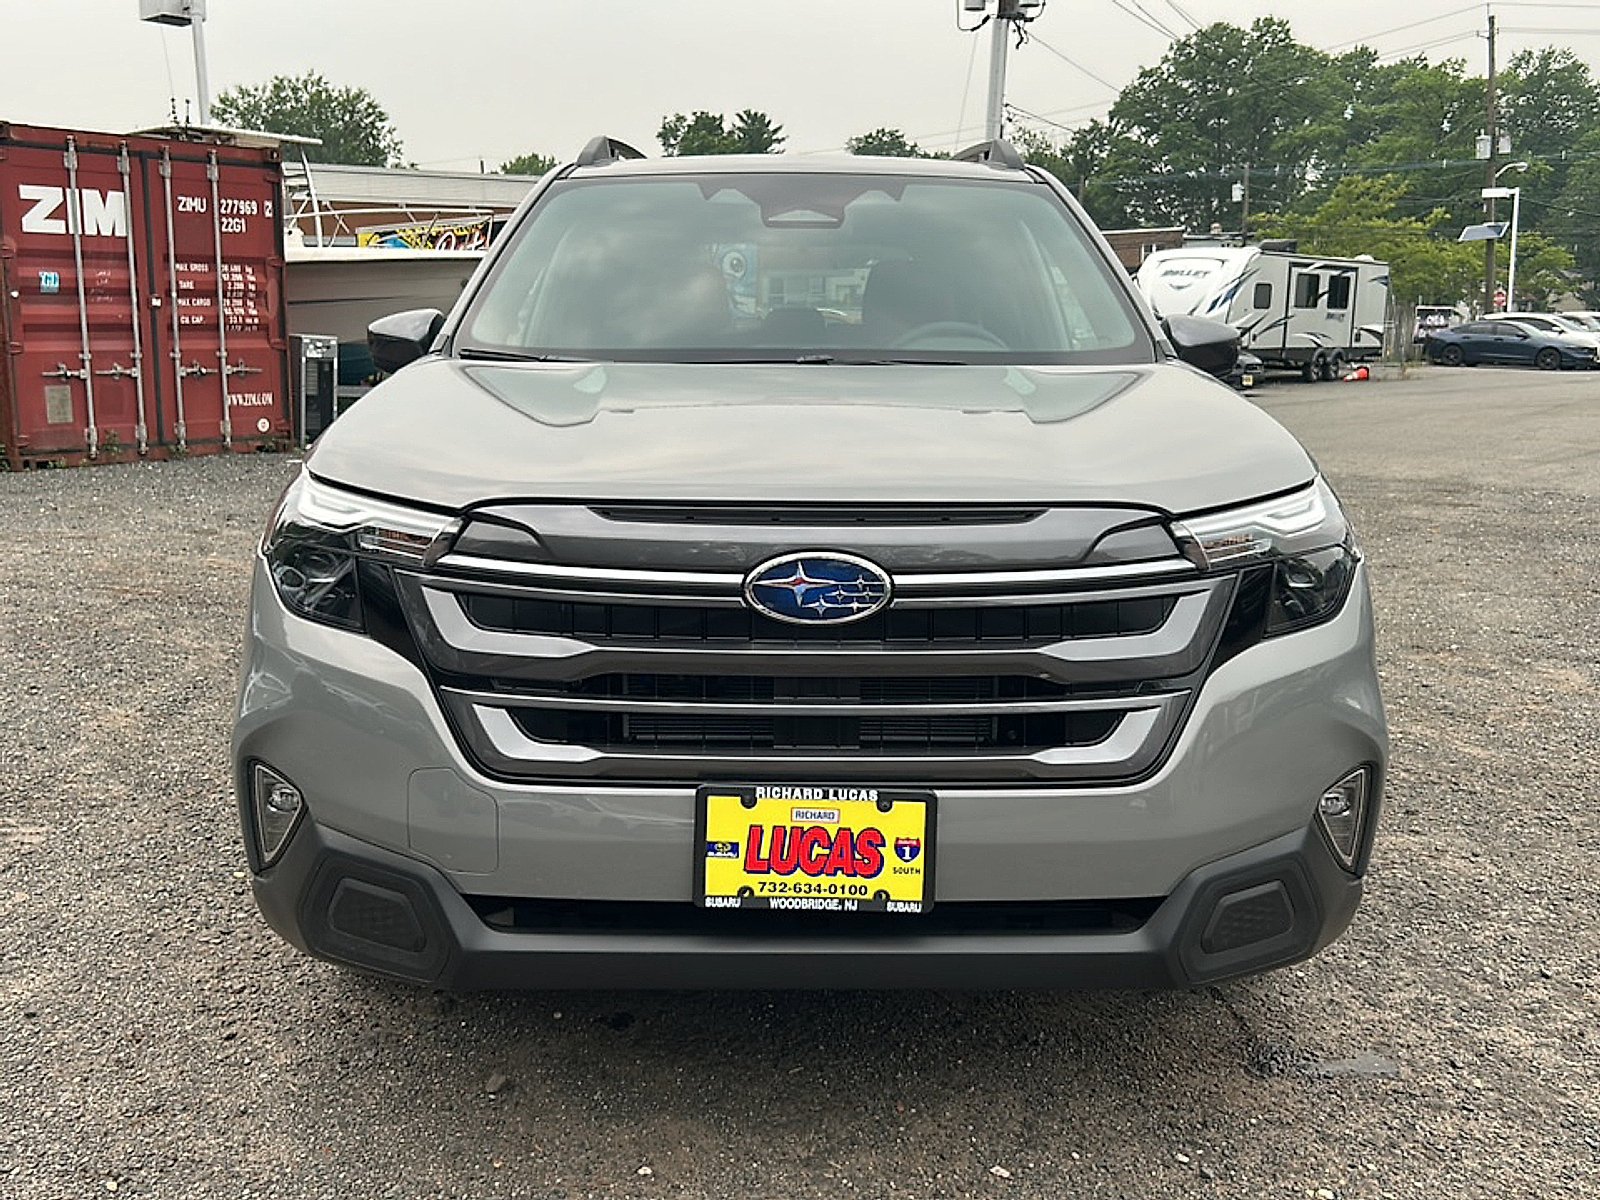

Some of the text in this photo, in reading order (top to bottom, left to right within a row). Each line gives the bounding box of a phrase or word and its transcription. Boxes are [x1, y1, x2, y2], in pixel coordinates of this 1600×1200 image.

[18, 184, 128, 237] ZIM
[177, 196, 207, 213] ZIMU
[220, 198, 258, 215] 277969
[221, 217, 246, 233] 22G1
[756, 787, 879, 802] RICHARD LUCAS
[794, 809, 836, 821] RICHARD
[744, 823, 887, 879] LUCAS
[901, 845, 912, 861] 1
[892, 866, 921, 875] SOUTH
[705, 896, 742, 908] SUBARU
[843, 899, 858, 911] NJ
[886, 901, 922, 913] SUBARU
